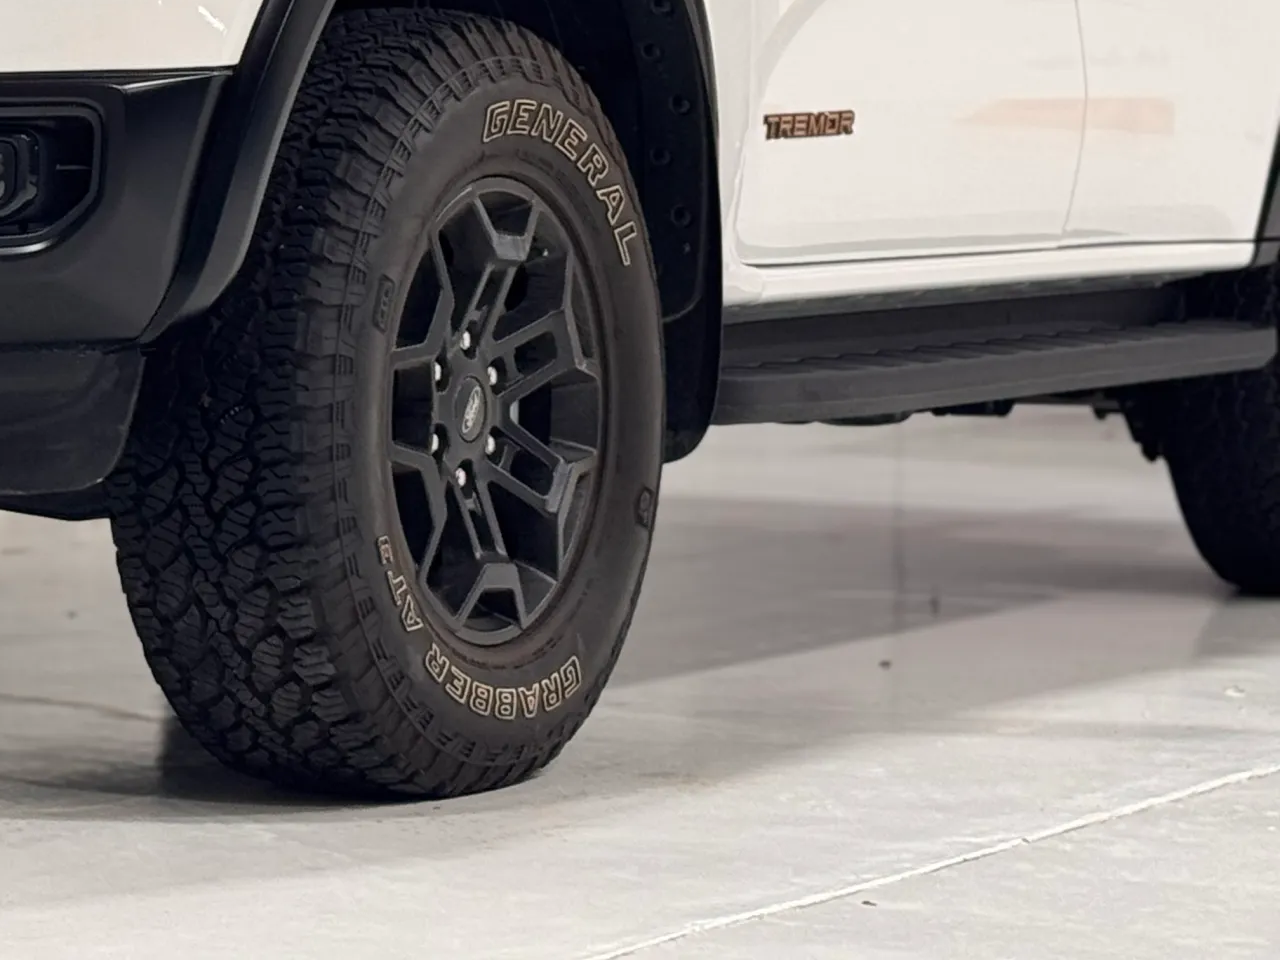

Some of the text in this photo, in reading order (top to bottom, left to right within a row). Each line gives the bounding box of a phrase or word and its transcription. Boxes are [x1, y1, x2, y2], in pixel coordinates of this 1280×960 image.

[763, 110, 855, 140] TREMOR
[483, 99, 638, 266] GENERAL
[424, 644, 581, 721] GRABBER
